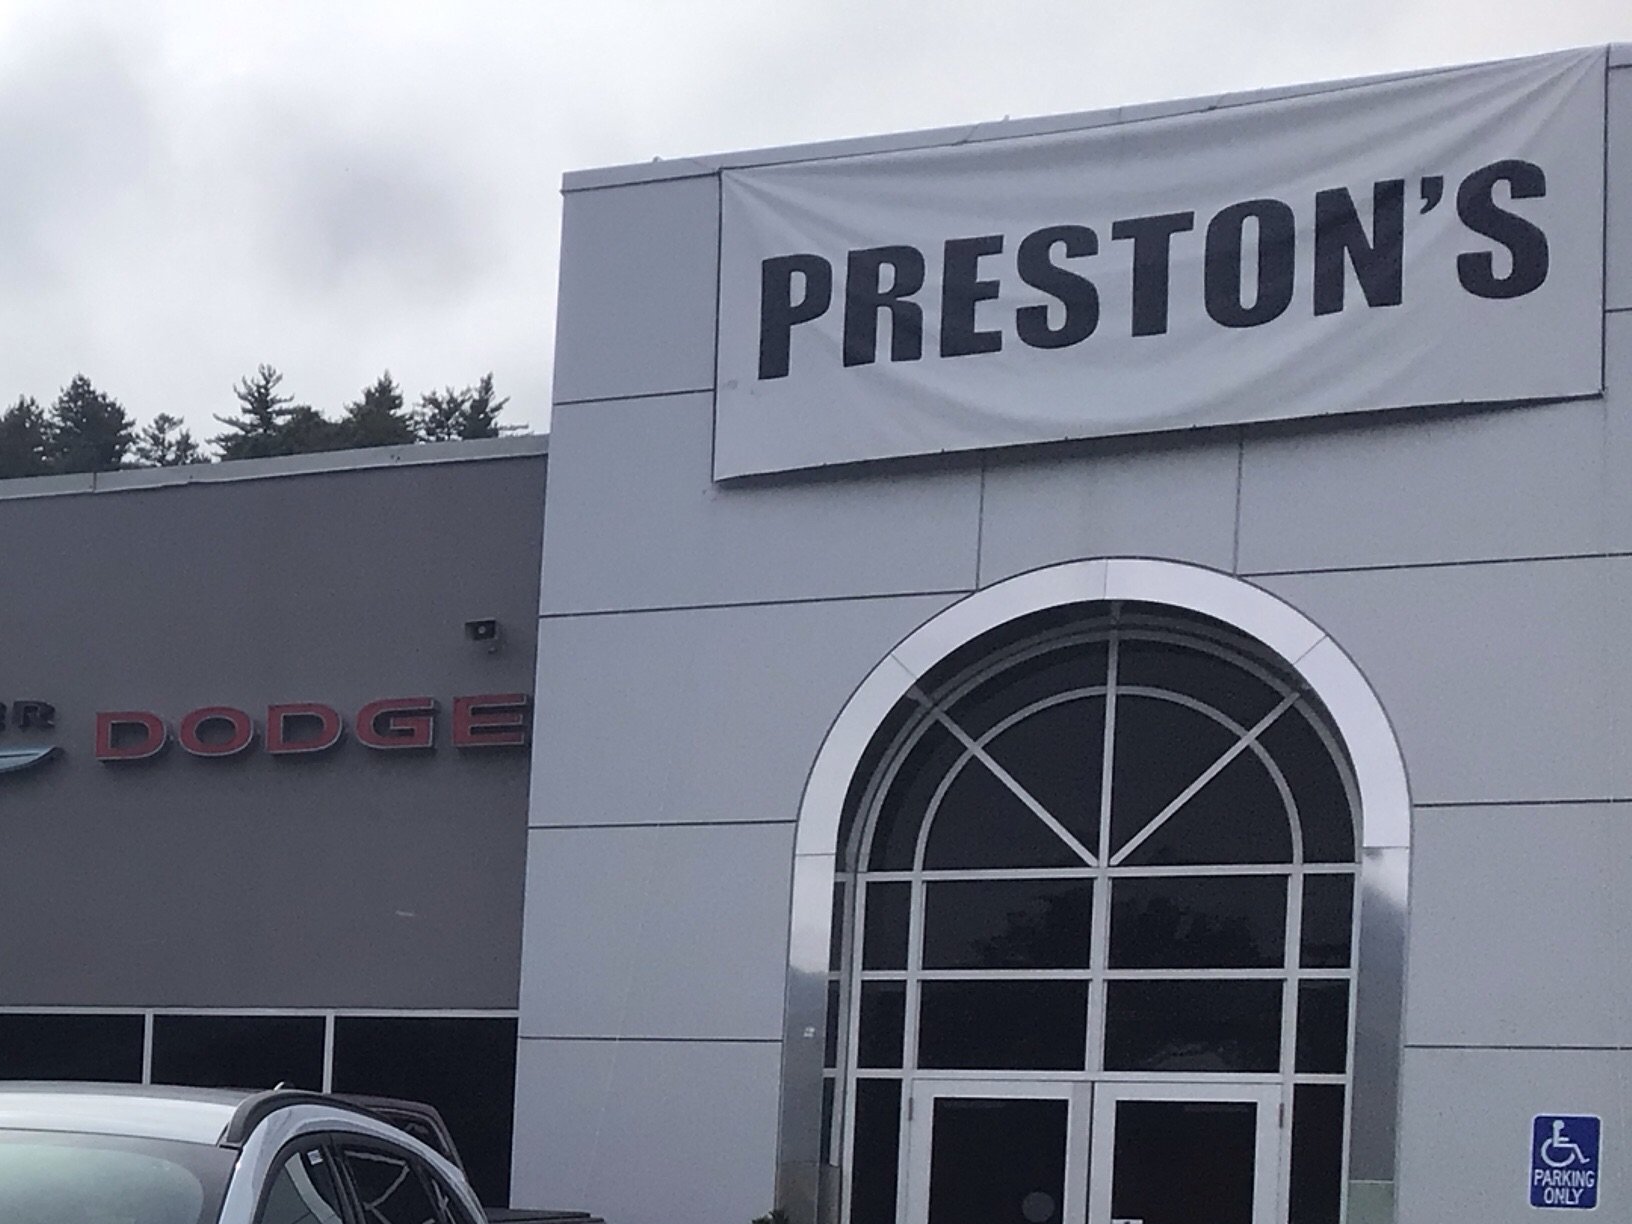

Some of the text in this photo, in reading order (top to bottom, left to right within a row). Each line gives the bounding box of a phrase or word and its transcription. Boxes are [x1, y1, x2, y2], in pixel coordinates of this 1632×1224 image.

[758, 159, 1550, 380] PRESTON'S
[95, 693, 528, 762] DODGE
[1533, 1168, 1595, 1188] PARKING
[1543, 1187, 1584, 1205] ONLY
